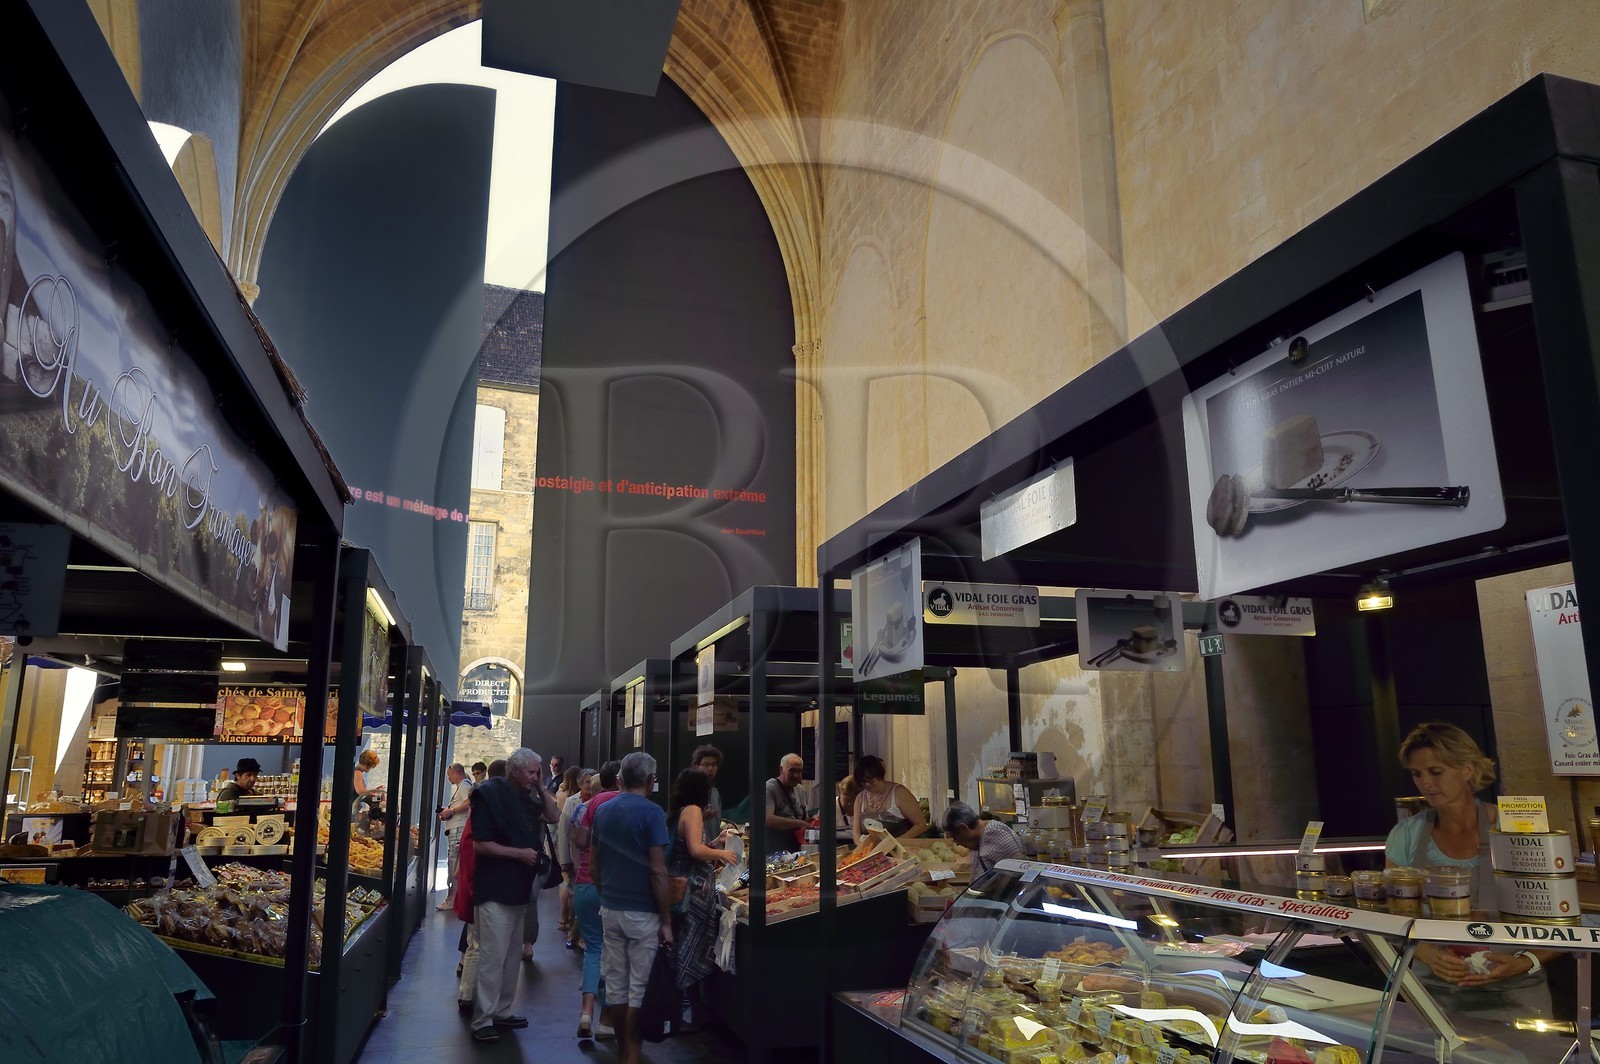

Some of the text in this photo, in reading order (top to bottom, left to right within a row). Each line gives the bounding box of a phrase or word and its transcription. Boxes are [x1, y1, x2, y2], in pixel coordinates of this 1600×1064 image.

[1261, 387, 1278, 402] GRAS
[1279, 375, 1304, 393] ENTIER
[1304, 360, 1334, 381] MI-CUIT
[1335, 344, 1368, 366] NATURE
[18, 274, 104, 434] Au
[108, 368, 178, 498] Bon
[598, 479, 613, 493] et
[616, 479, 709, 500] d'anticipation
[713, 486, 767, 503] extrême
[1026, 486, 1047, 508] FOIE
[365, 490, 384, 504] est
[386, 495, 400, 508] un
[403, 499, 448, 520] mélange
[450, 509, 463, 522] de
[955, 592, 1037, 606] VIDAL FOIE GRAS
[930, 603, 951, 612] VIDAL
[967, 603, 1025, 613] Artisan Conserveur
[1241, 604, 1312, 616] VIDAL FOIE GRAS
[1273, 615, 1302, 623] Conserveur
[475, 679, 505, 687] DIRECT
[248, 687, 263, 698] de
[266, 687, 305, 699] Sainte
[462, 687, 517, 696] PRODUCTEUR
[863, 691, 921, 704] Légumes
[219, 734, 268, 744] Macarons
[1578, 751, 1591, 759] Gras
[1509, 838, 1544, 847] VIDAL
[1514, 880, 1550, 891] VIDAL
[1137, 878, 1178, 891] Produits
[1178, 884, 1202, 895] frais
[1210, 889, 1235, 901] Foie
[1238, 893, 1268, 907] Gras
[1278, 899, 1354, 920] Spécialités
[1503, 924, 1582, 942] VIDAL
